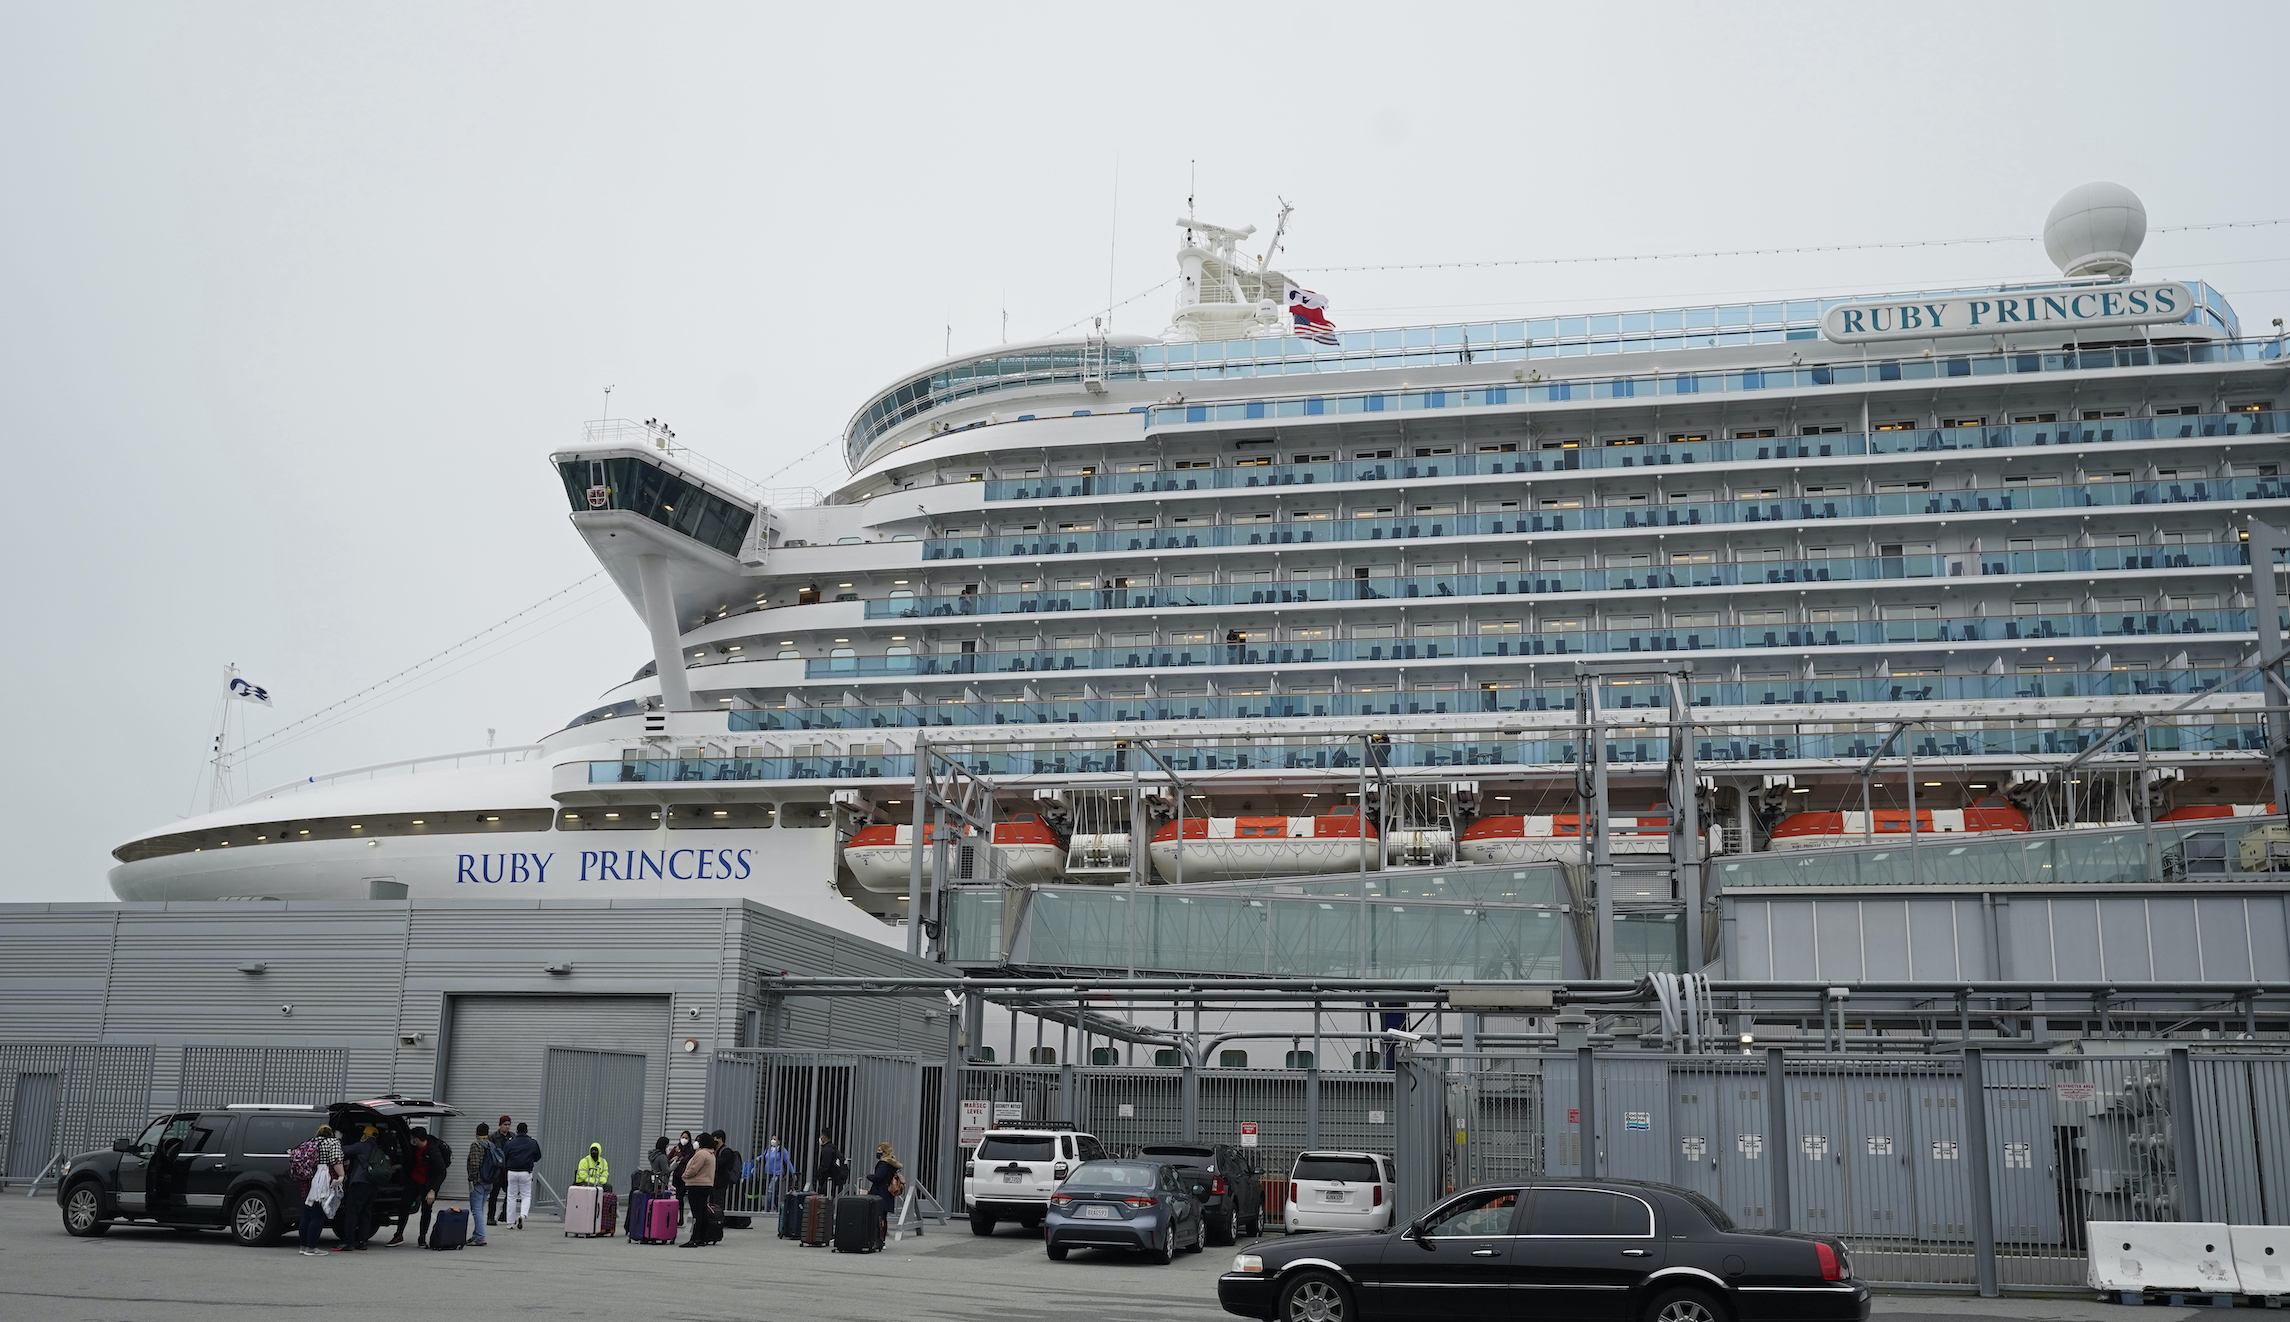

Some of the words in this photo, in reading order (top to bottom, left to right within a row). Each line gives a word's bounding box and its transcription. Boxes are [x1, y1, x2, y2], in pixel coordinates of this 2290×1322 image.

[1842, 303, 1948, 334] RUBY
[1967, 287, 2176, 326] PRINCESS
[456, 852, 555, 883] RUBY
[578, 849, 752, 881] PRINCESS
[972, 1116, 976, 1124] 1
